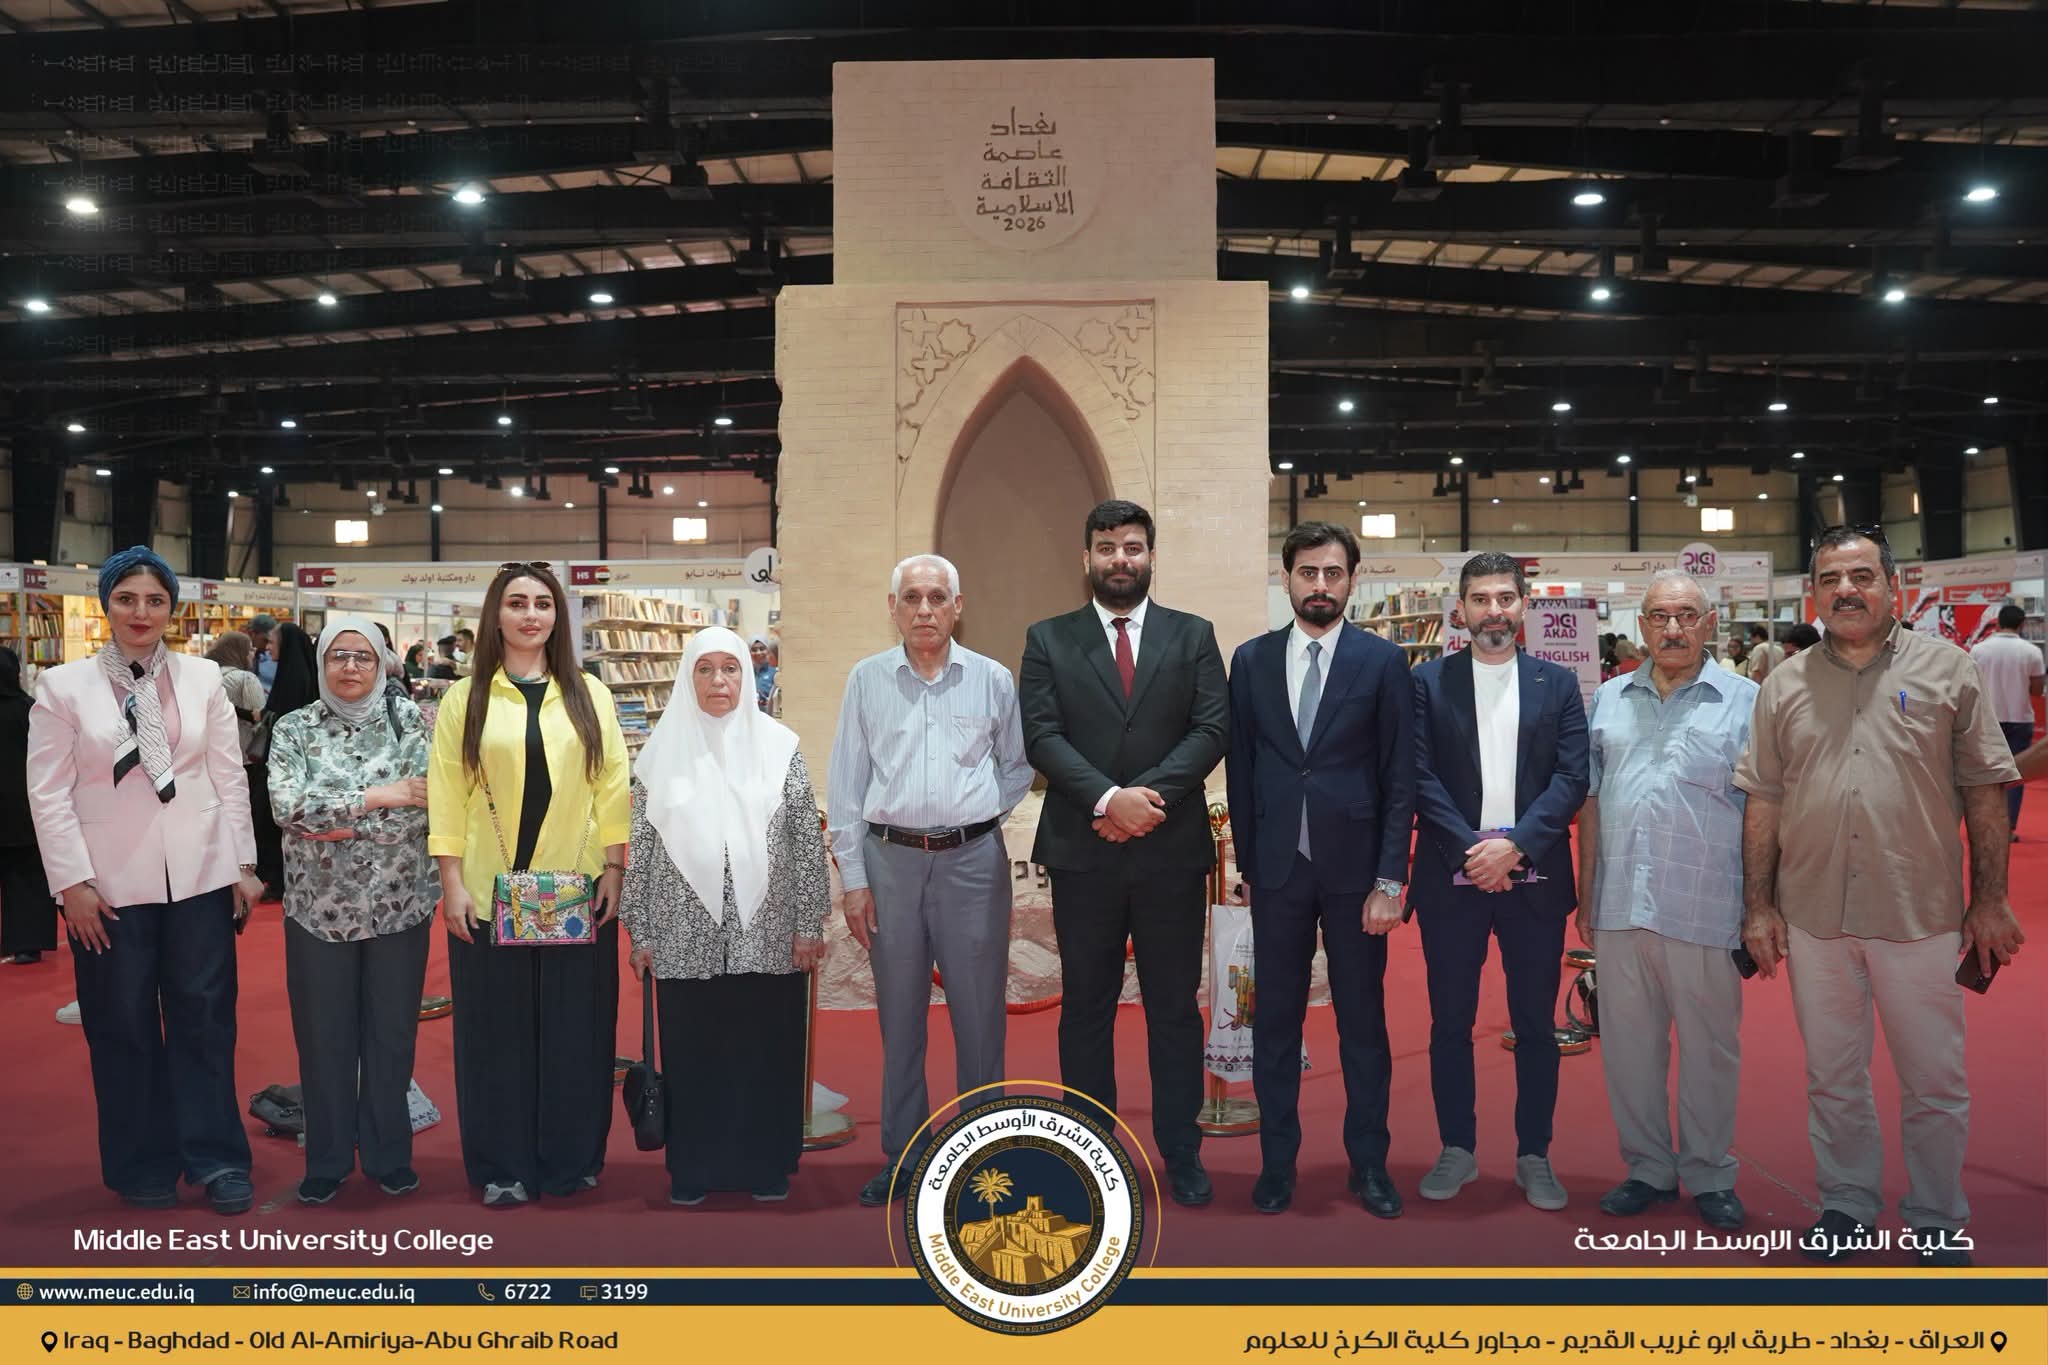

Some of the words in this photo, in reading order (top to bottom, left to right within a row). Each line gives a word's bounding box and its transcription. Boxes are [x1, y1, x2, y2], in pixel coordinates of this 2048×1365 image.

[988, 105, 1057, 136] بغداد
[983, 139, 1063, 164] عاصمة
[981, 164, 1066, 190] الثقافة
[976, 189, 1074, 220] الاسلامية
[1003, 216, 1046, 232] 2026
[1652, 561, 1667, 573] دار
[1684, 565, 1716, 575] AKAD
[464, 573, 476, 584] دار
[576, 572, 590, 580] H5
[1543, 628, 1577, 639] AKAD
[1535, 650, 1590, 662] ENGLISH
